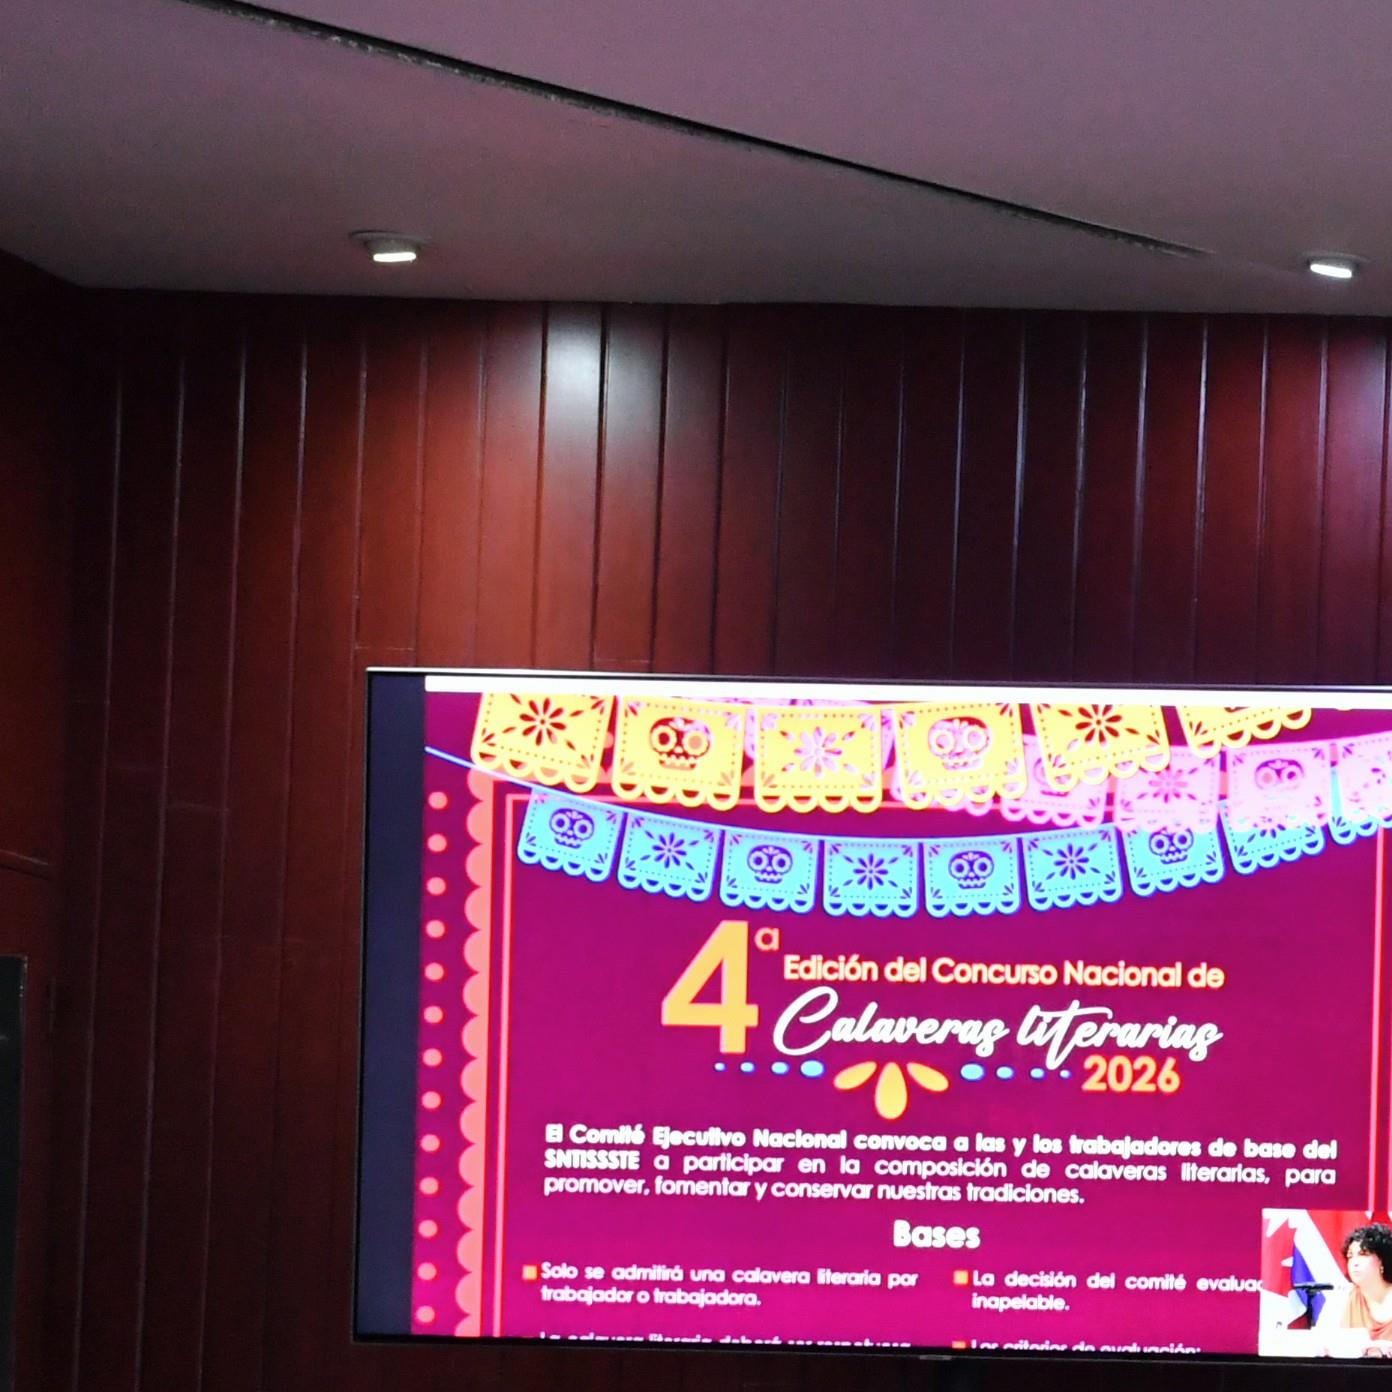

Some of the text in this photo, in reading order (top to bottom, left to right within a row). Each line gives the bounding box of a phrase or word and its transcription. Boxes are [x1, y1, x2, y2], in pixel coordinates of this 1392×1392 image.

[783, 955, 879, 981] Edición
[883, 957, 927, 983] del
[932, 957, 1058, 986] Concurso
[1064, 960, 1183, 987] Nacional
[1187, 962, 1225, 988] de
[773, 986, 1224, 1070] Calaveras literarias
[1082, 1055, 1180, 1093] 2026
[546, 1124, 1338, 1159] El Comité Ejecutivo Nacional convoca a las y los trabajadores de base del
[653, 1155, 670, 1170] a
[683, 1153, 785, 1175] participar
[798, 1157, 826, 1173] en
[840, 1155, 861, 1174] la
[874, 1157, 1007, 1179] composición
[1020, 1159, 1051, 1178] de
[1065, 1161, 1167, 1181] calaveras
[1181, 1163, 1270, 1184] literarias,
[1285, 1168, 1337, 1187] para
[544, 1176, 1085, 1204] promover, fomentar y conservar nuestras tradiciones.
[894, 1220, 981, 1249] Bases
[541, 1262, 919, 1289] Solo se admitirá una calavera literaria por
[972, 1271, 994, 1287] La
[1004, 1271, 1077, 1288] decisión
[1087, 1273, 1116, 1289] del
[1125, 1273, 1187, 1291] comité
[541, 1286, 762, 1308] trabajador o trabajadora.
[972, 1293, 1070, 1313] inapelable.
